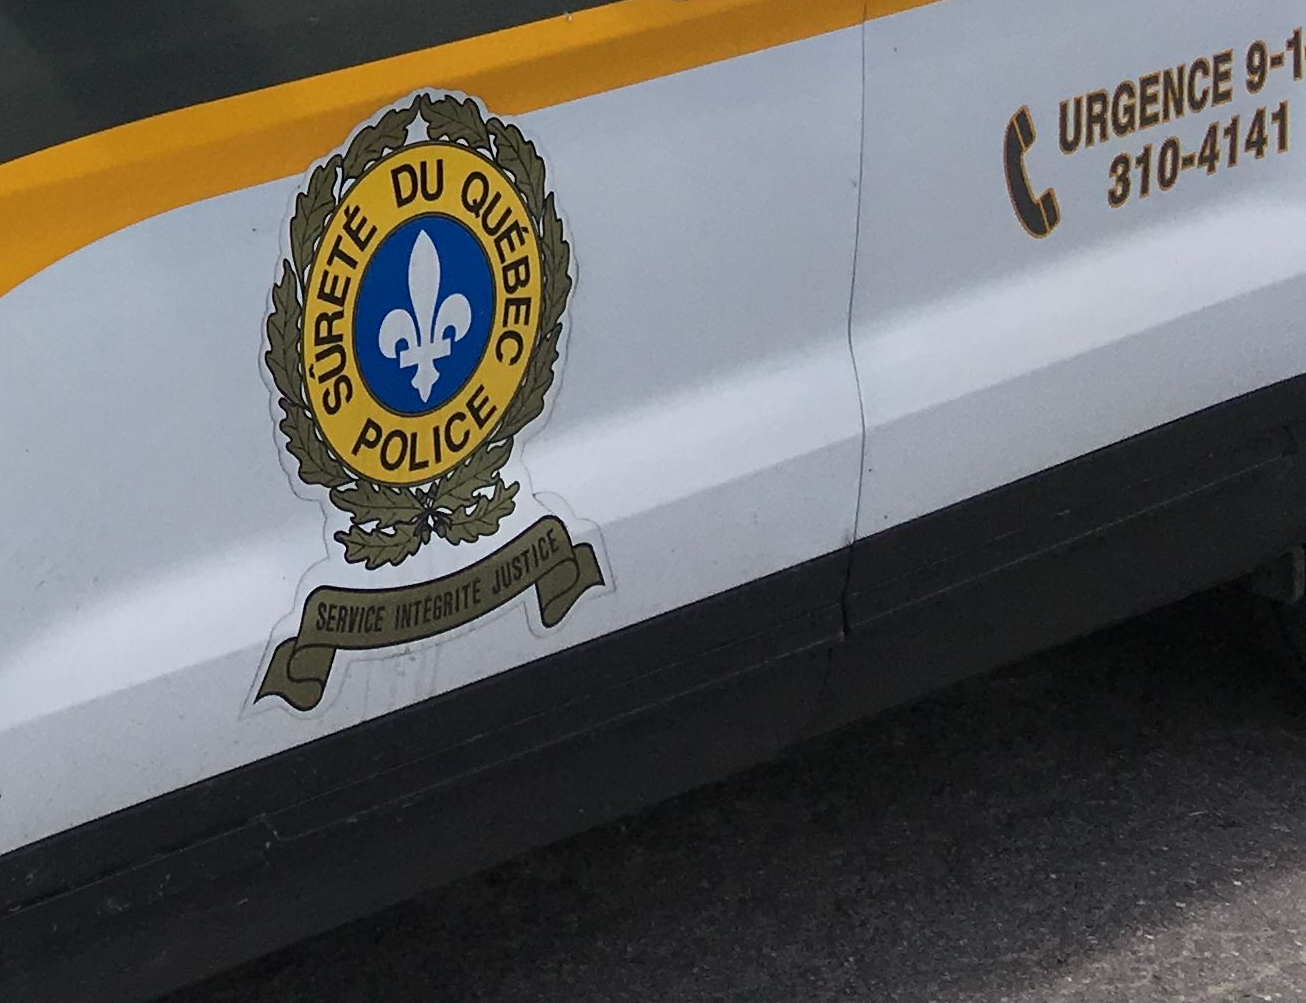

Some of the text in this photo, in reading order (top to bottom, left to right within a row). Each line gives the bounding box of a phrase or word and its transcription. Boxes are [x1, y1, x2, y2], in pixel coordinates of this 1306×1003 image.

[1058, 26, 1306, 156] URGENCE 9-1
[1107, 99, 1289, 209] 310-4141
[309, 158, 532, 416] SÛRETÉ DU QUÉBEC
[351, 384, 498, 472] POLICE
[315, 601, 386, 634] SERVICE
[491, 527, 560, 595] JUSTICE
